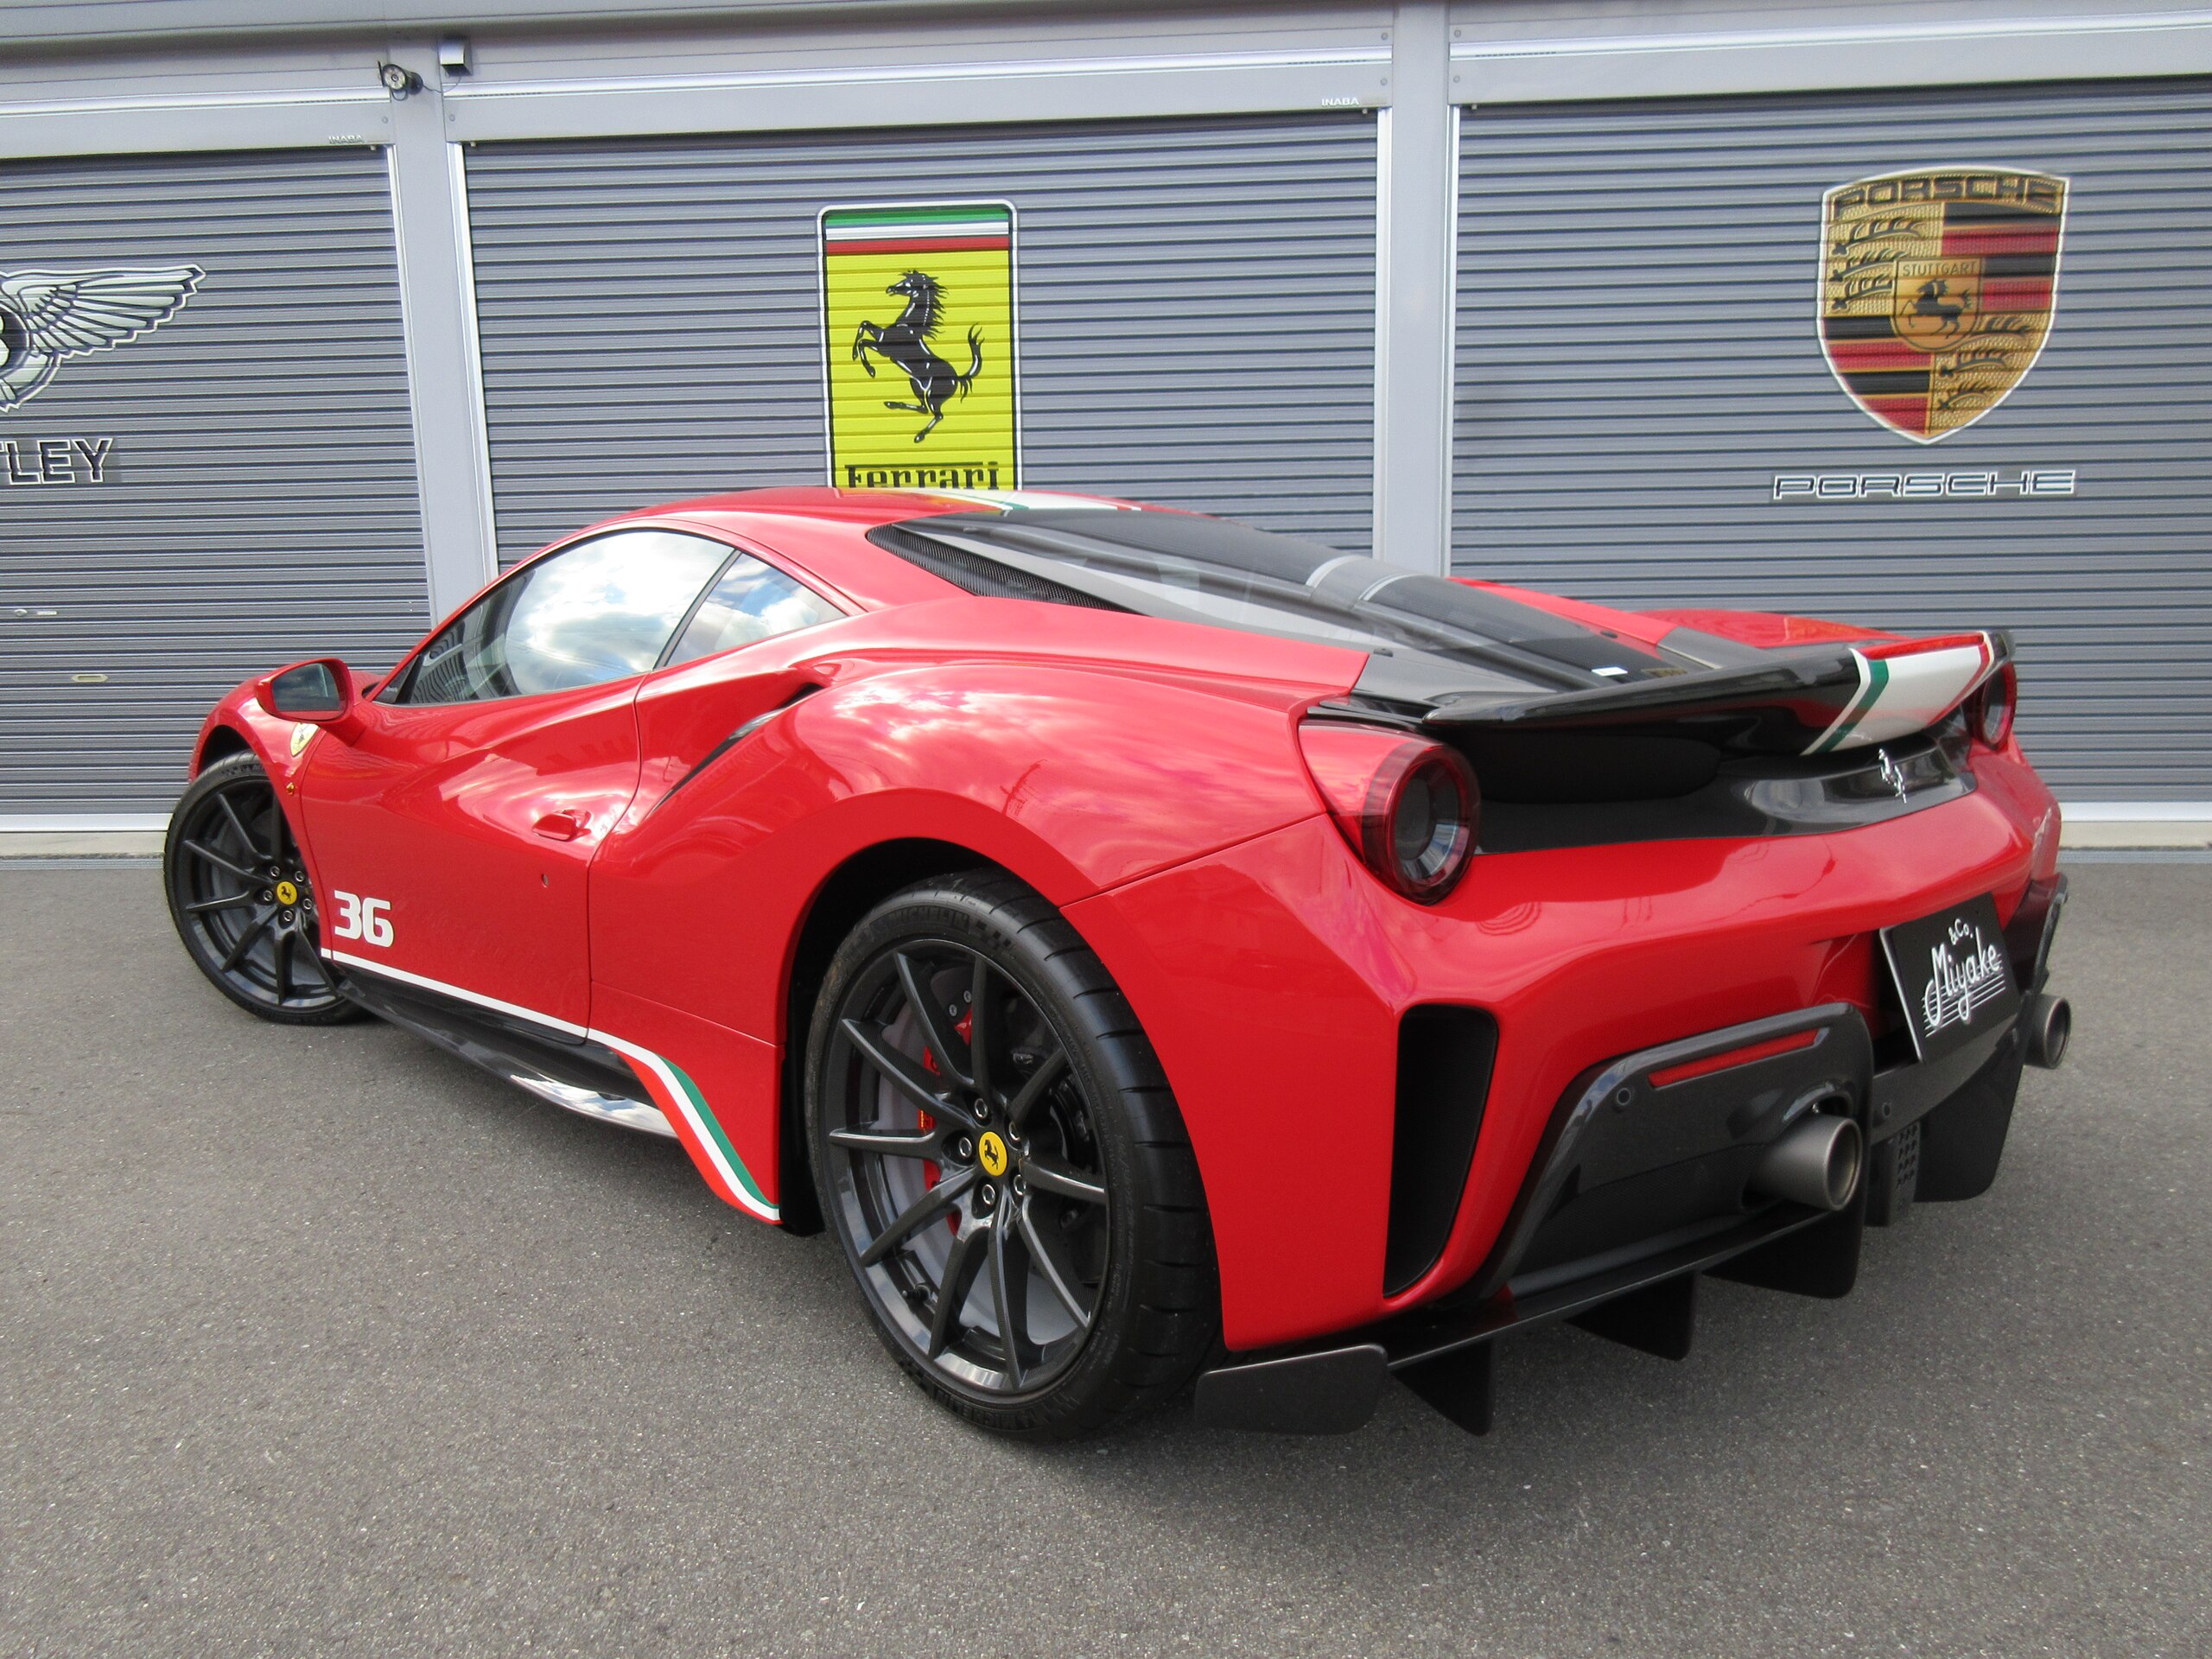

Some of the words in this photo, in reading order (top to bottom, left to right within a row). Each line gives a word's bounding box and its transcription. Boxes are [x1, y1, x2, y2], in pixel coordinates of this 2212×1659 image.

[1321, 97, 1360, 105] INABA
[1833, 175, 2063, 219] PORSCHE
[1902, 260, 1978, 276] STUTTGART
[0, 438, 113, 486] LEY
[844, 461, 1000, 490] Ferrari
[1773, 469, 2075, 499] PORSCHE
[334, 889, 395, 948] 36
[1948, 918, 1974, 945] &Co.
[1924, 926, 2000, 1027] Miyake
